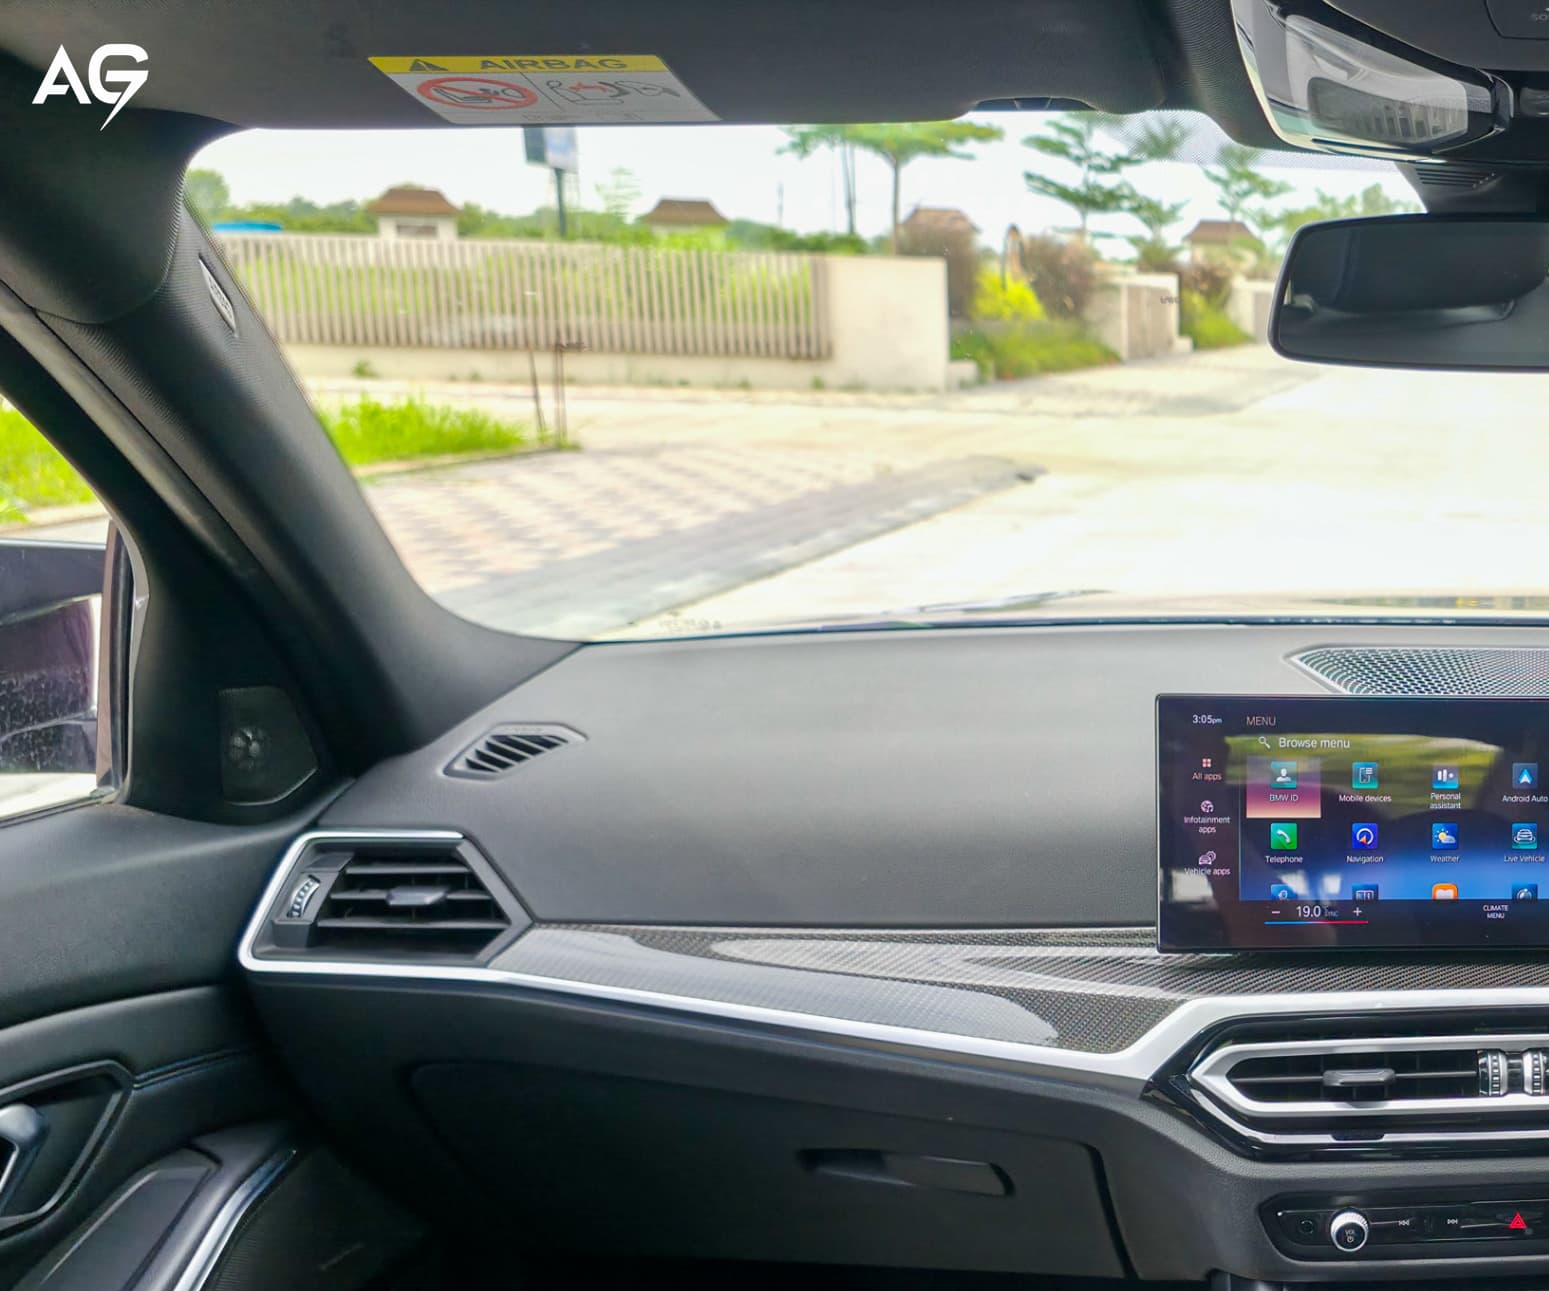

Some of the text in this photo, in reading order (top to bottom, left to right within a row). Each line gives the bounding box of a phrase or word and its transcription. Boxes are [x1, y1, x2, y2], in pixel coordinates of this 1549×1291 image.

[480, 58, 628, 70] AIRBAG
[1246, 716, 1277, 726] MENU
[1278, 737, 1351, 749] Browse menu
[1192, 772, 1222, 782] All apps
[1269, 794, 1299, 802] BMW ID
[1338, 794, 1392, 803] Mobile devices
[1430, 792, 1461, 801] Personal
[1502, 794, 1549, 803] Android Auto
[1430, 801, 1461, 810] assistant
[1183, 816, 1231, 824] Infotainment
[1198, 825, 1217, 834] apps
[1265, 855, 1303, 864] Telephone
[1346, 854, 1384, 864] Navigation
[1430, 854, 1460, 863] Weather
[1503, 854, 1545, 863] Live Vehicle
[1184, 867, 1231, 877] Vehicle apps
[1295, 905, 1322, 918] 19.0
[1482, 904, 1509, 912] CLIMATE
